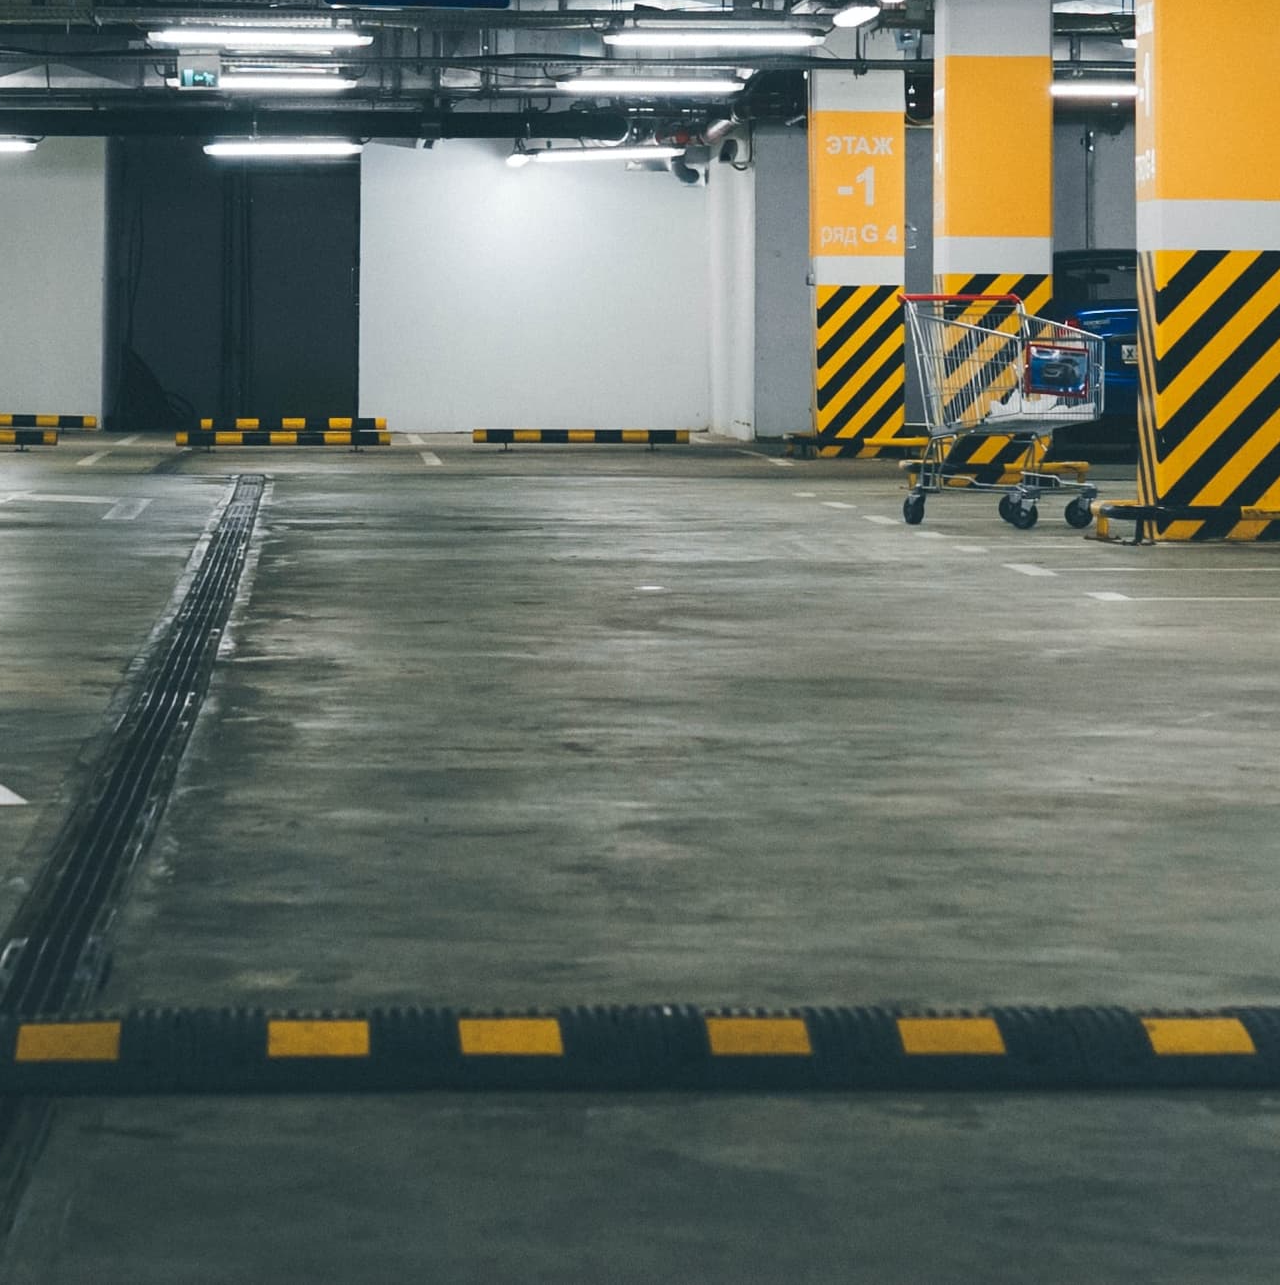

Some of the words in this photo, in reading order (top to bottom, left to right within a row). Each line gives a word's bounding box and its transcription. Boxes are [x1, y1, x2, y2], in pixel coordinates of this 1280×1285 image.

[826, 135, 894, 155] ЭТАЖ
[837, 165, 875, 207] -1
[861, 224, 878, 243] G
[885, 225, 897, 244] 4
